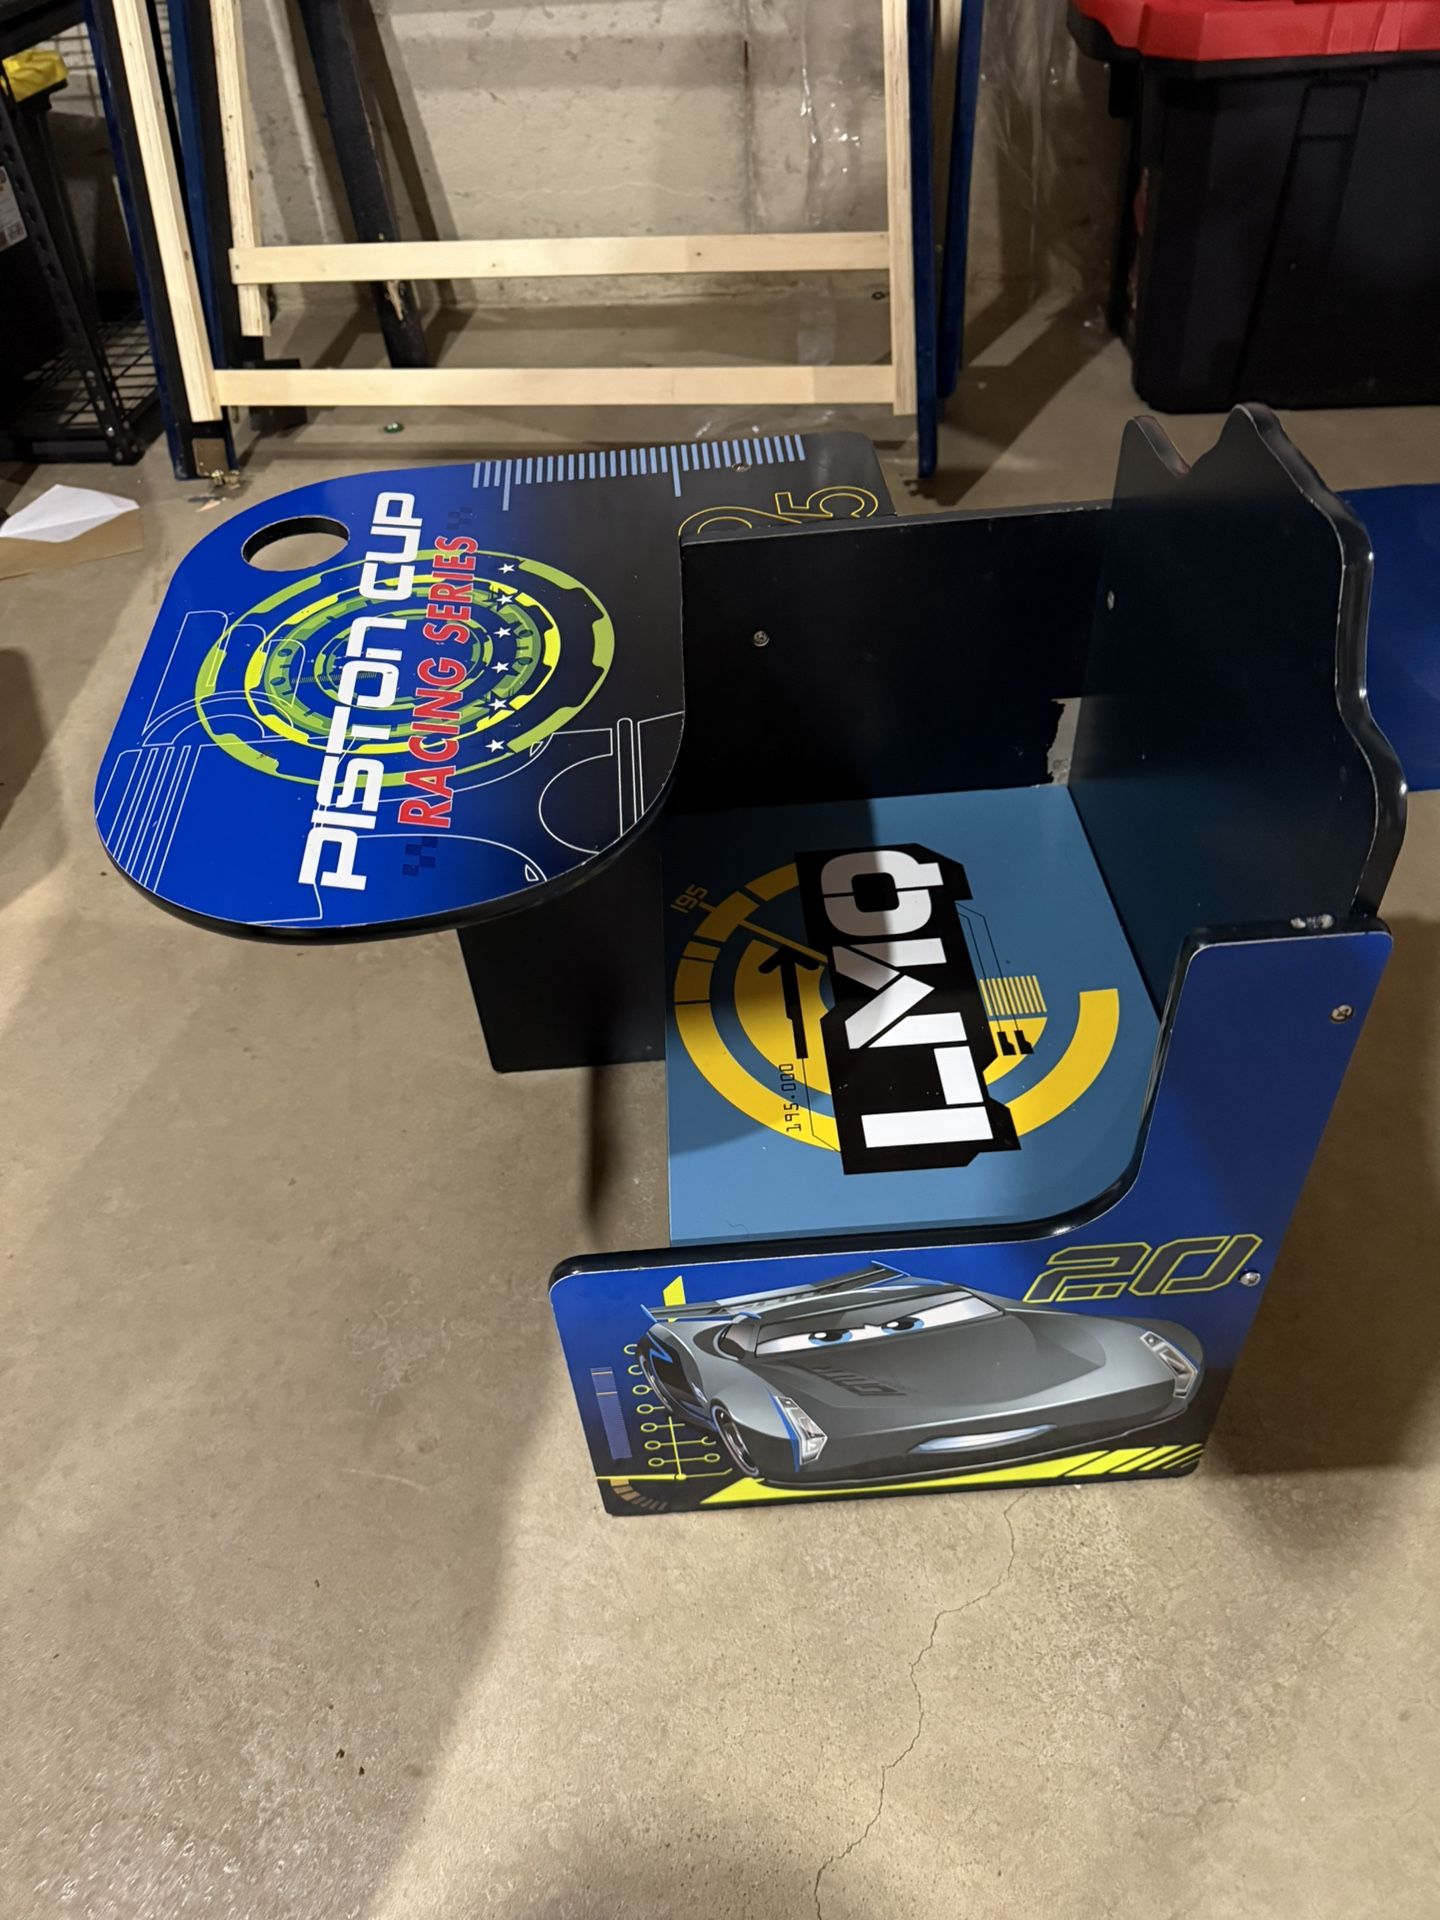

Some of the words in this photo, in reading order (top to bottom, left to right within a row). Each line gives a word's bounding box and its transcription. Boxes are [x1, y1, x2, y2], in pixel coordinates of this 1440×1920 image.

[423, 535, 479, 645] SERIES
[299, 617, 407, 890] PISTON
[359, 492, 423, 600] CUP
[398, 656, 468, 828] RACING
[671, 884, 708, 914] 195
[821, 850, 994, 1149] LMQ
